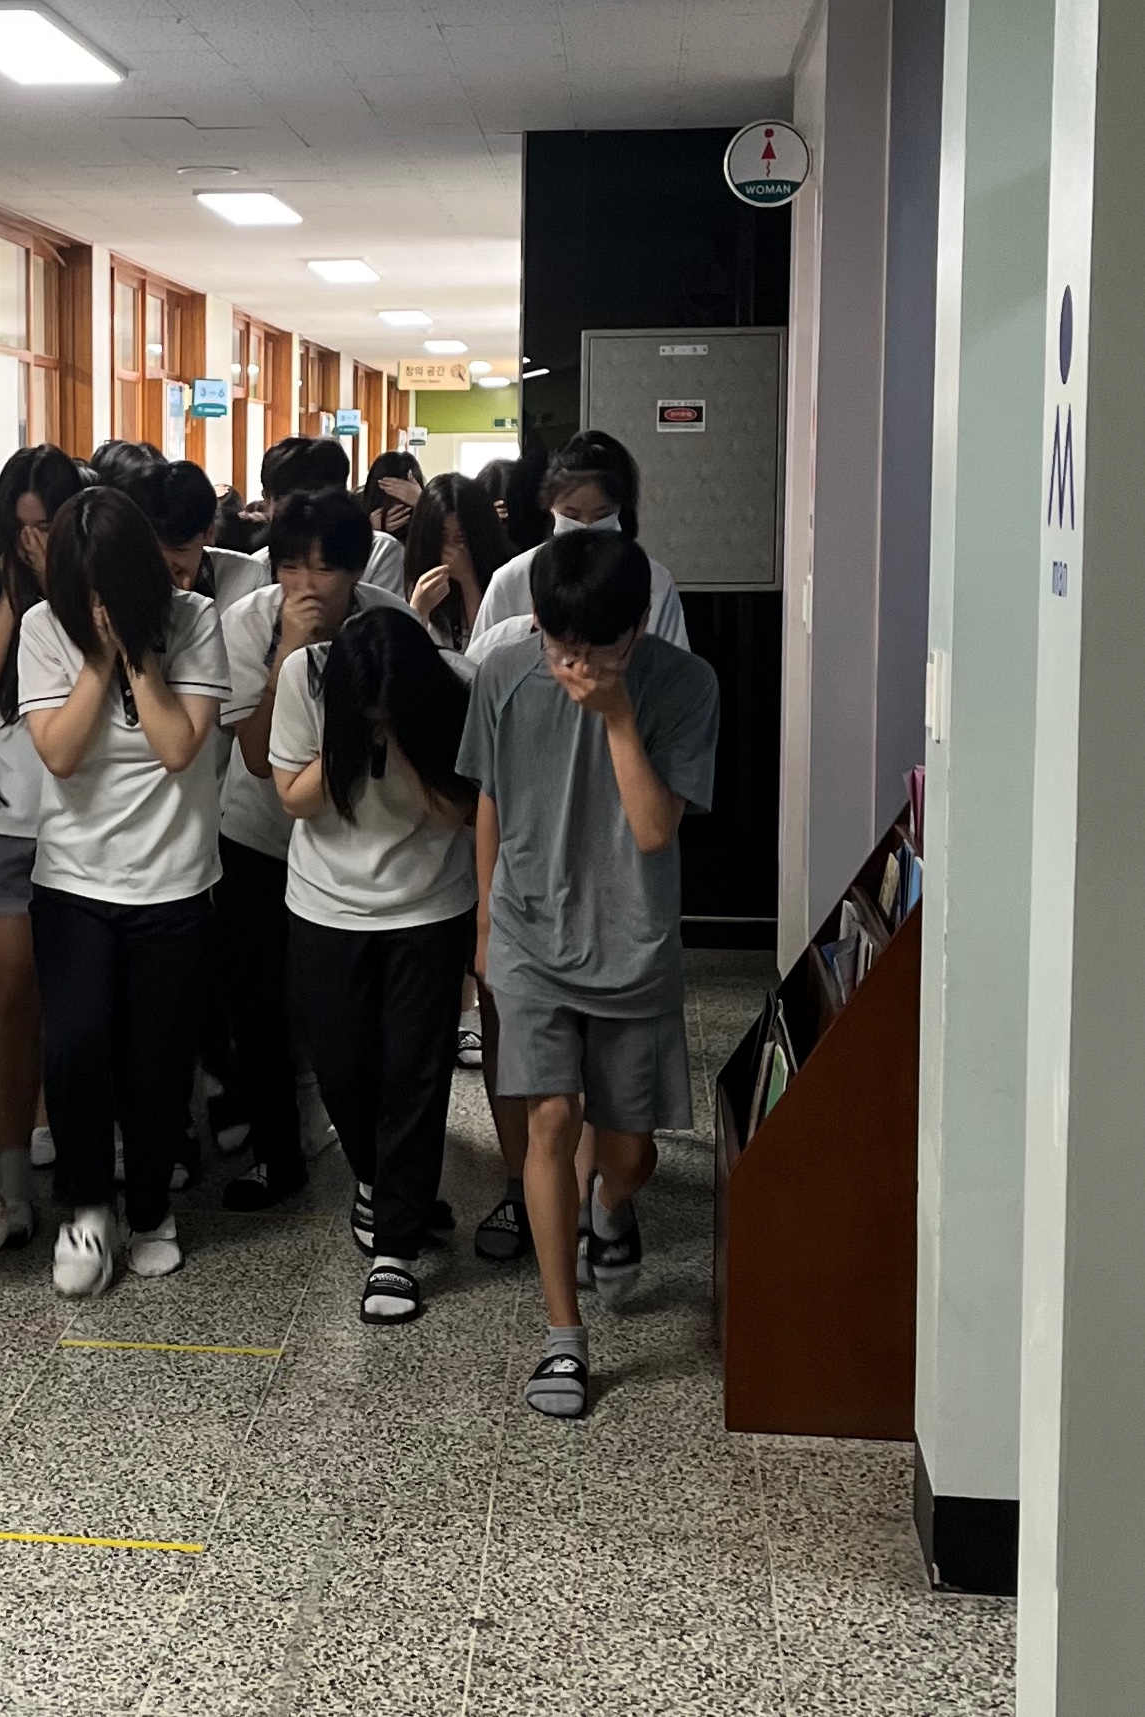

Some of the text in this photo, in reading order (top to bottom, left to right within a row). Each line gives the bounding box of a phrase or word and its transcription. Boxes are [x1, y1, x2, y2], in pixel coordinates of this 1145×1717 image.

[745, 184, 791, 195] WOMAN
[406, 365, 445, 377] 창의 공간
